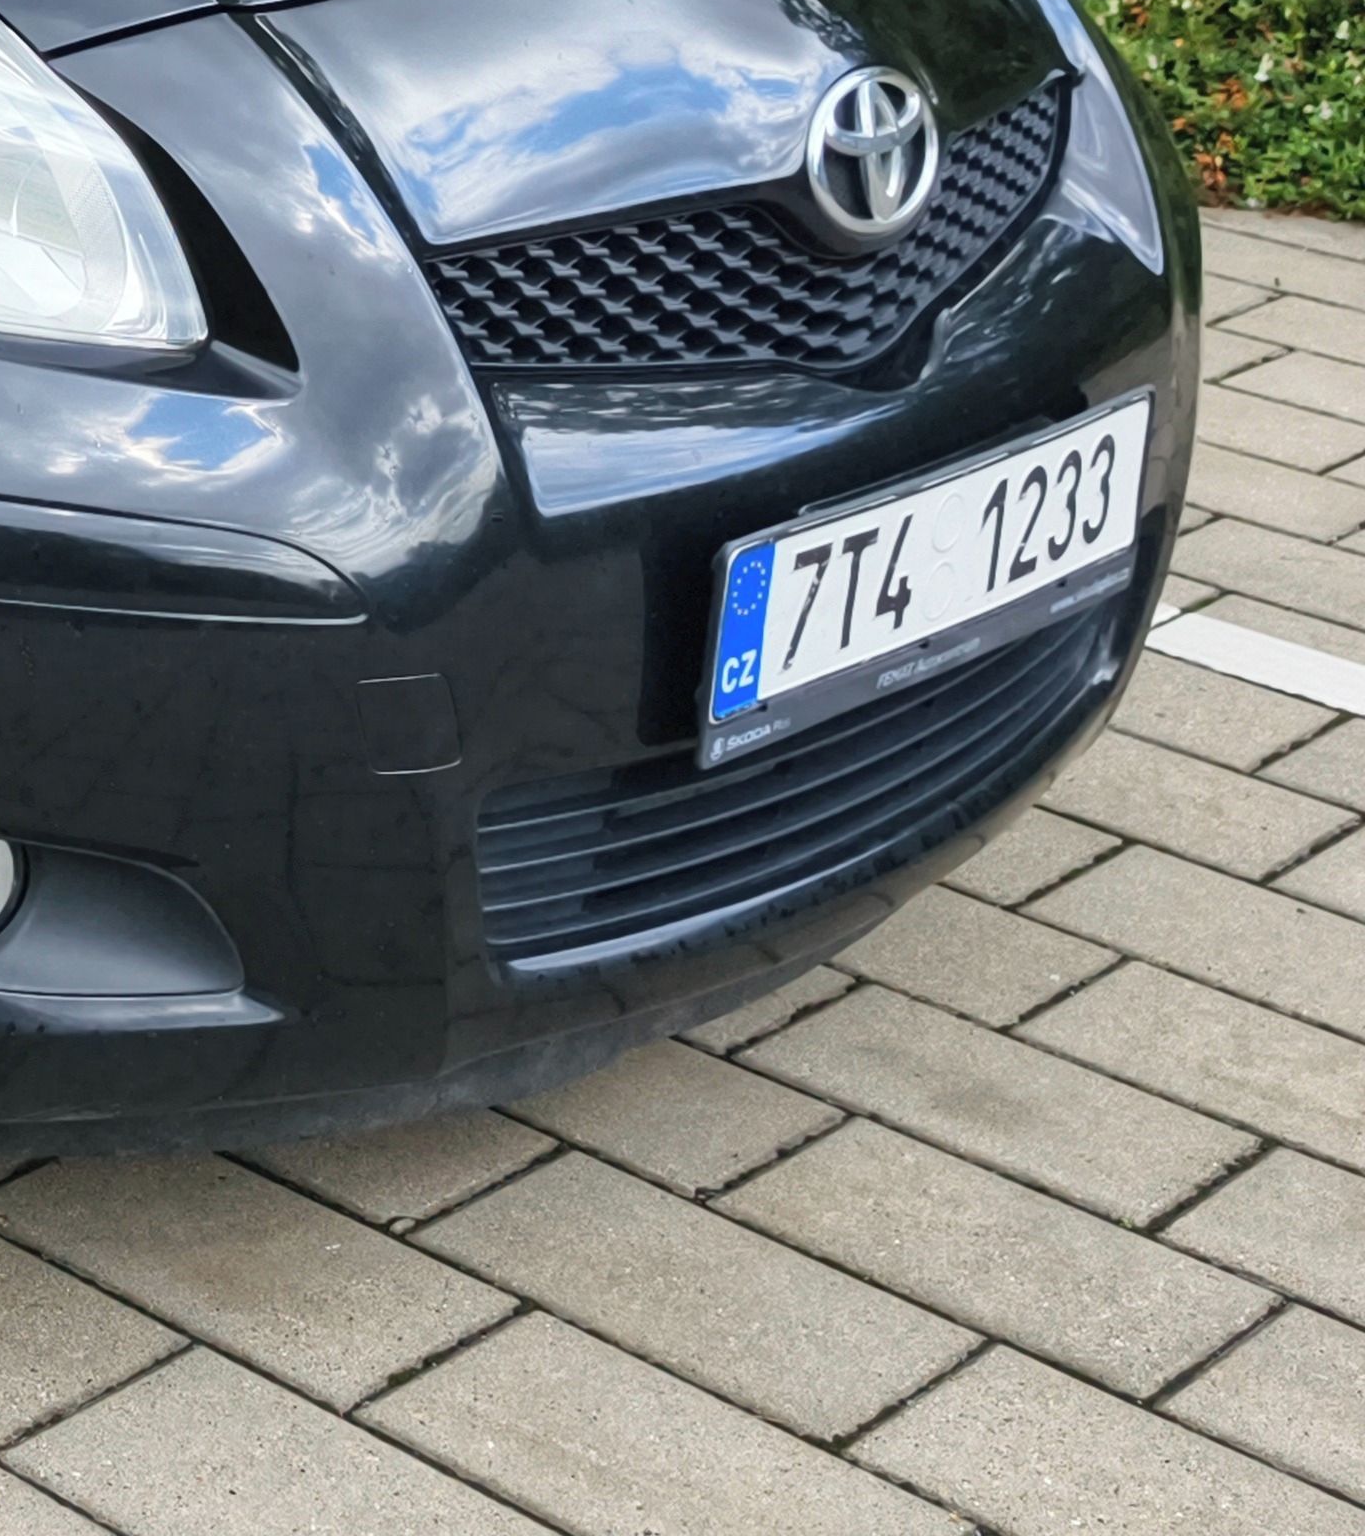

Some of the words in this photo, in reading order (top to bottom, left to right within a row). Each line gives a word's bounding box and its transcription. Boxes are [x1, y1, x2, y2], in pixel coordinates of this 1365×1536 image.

[782, 513, 914, 671] 7T4
[981, 434, 1116, 593] 1233
[722, 649, 758, 694] CZ
